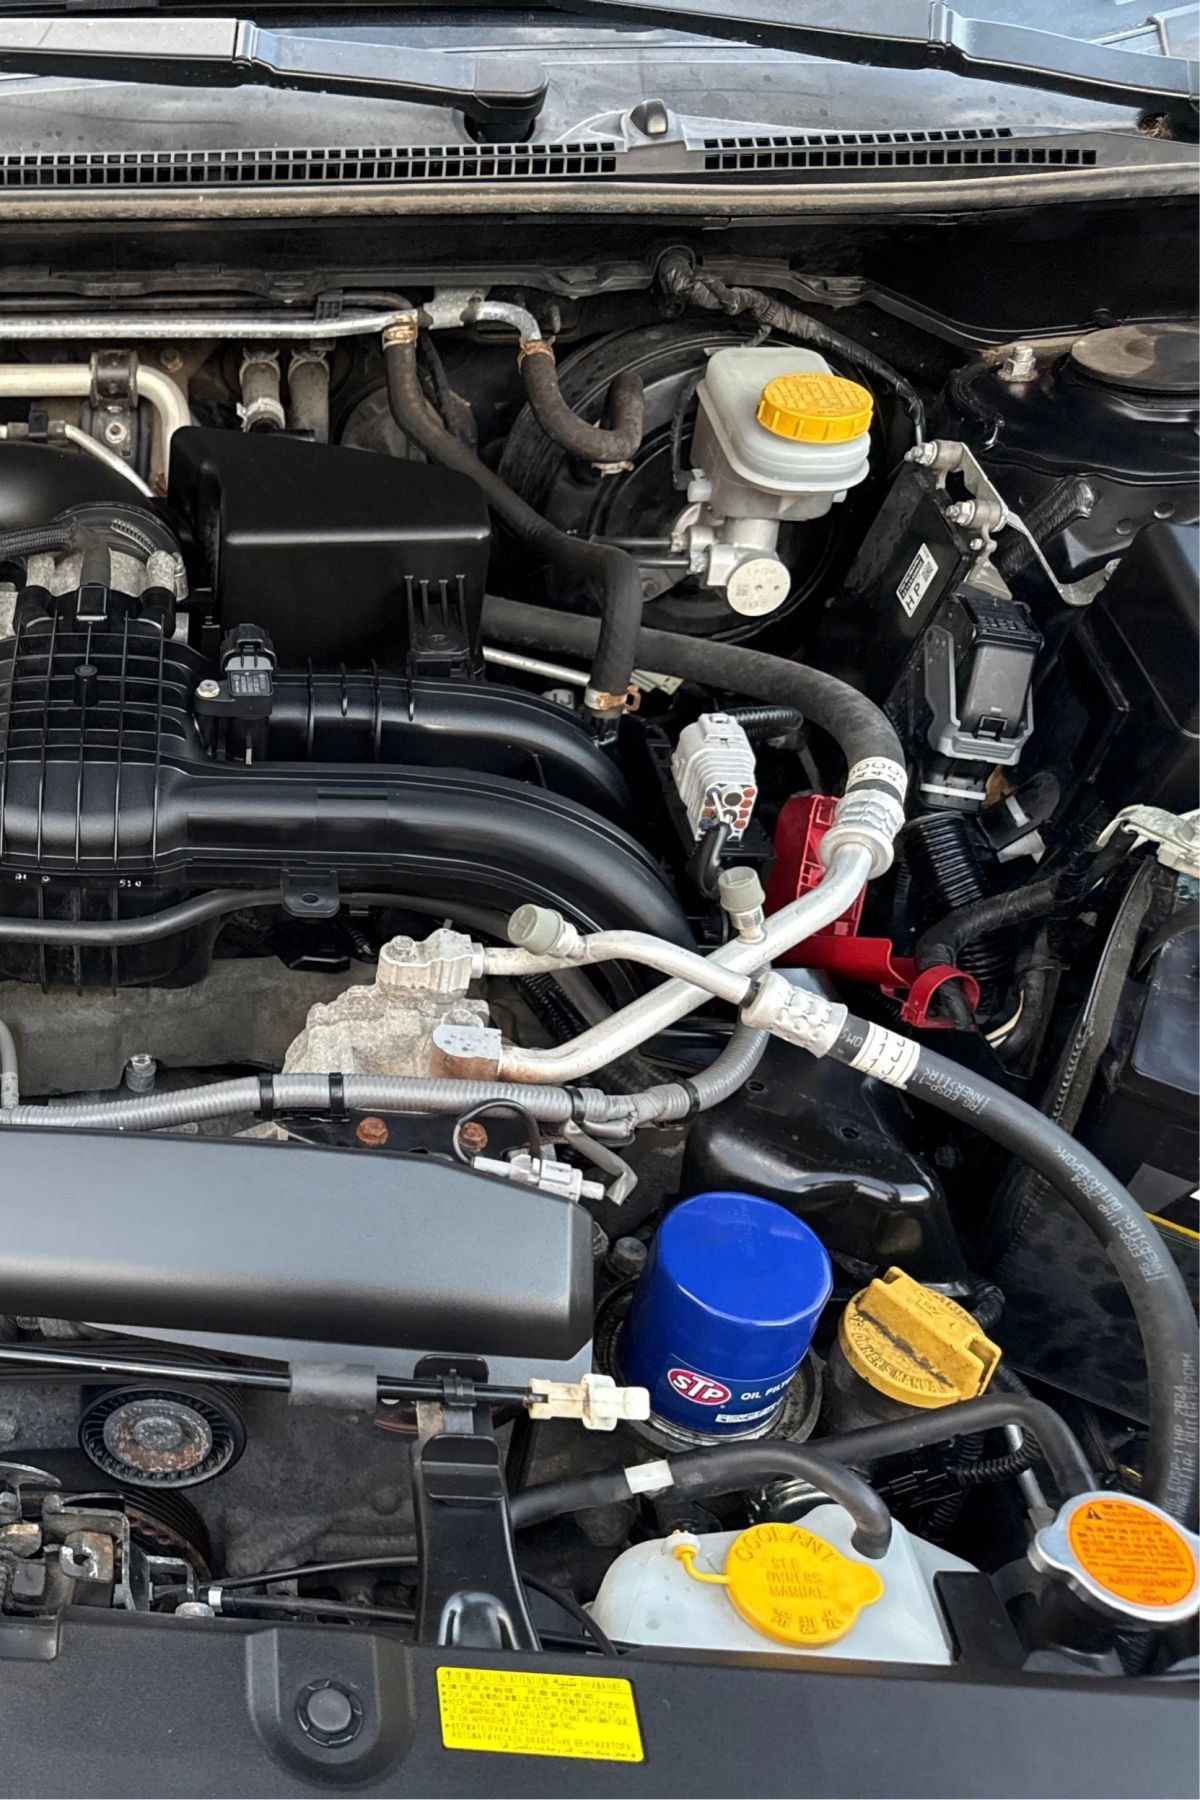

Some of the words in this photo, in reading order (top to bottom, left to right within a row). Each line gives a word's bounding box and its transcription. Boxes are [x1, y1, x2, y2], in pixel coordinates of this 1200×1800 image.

[673, 1375, 725, 1400] STP
[740, 1391, 761, 1401] OIL
[735, 1526, 838, 1562] COOLANT
